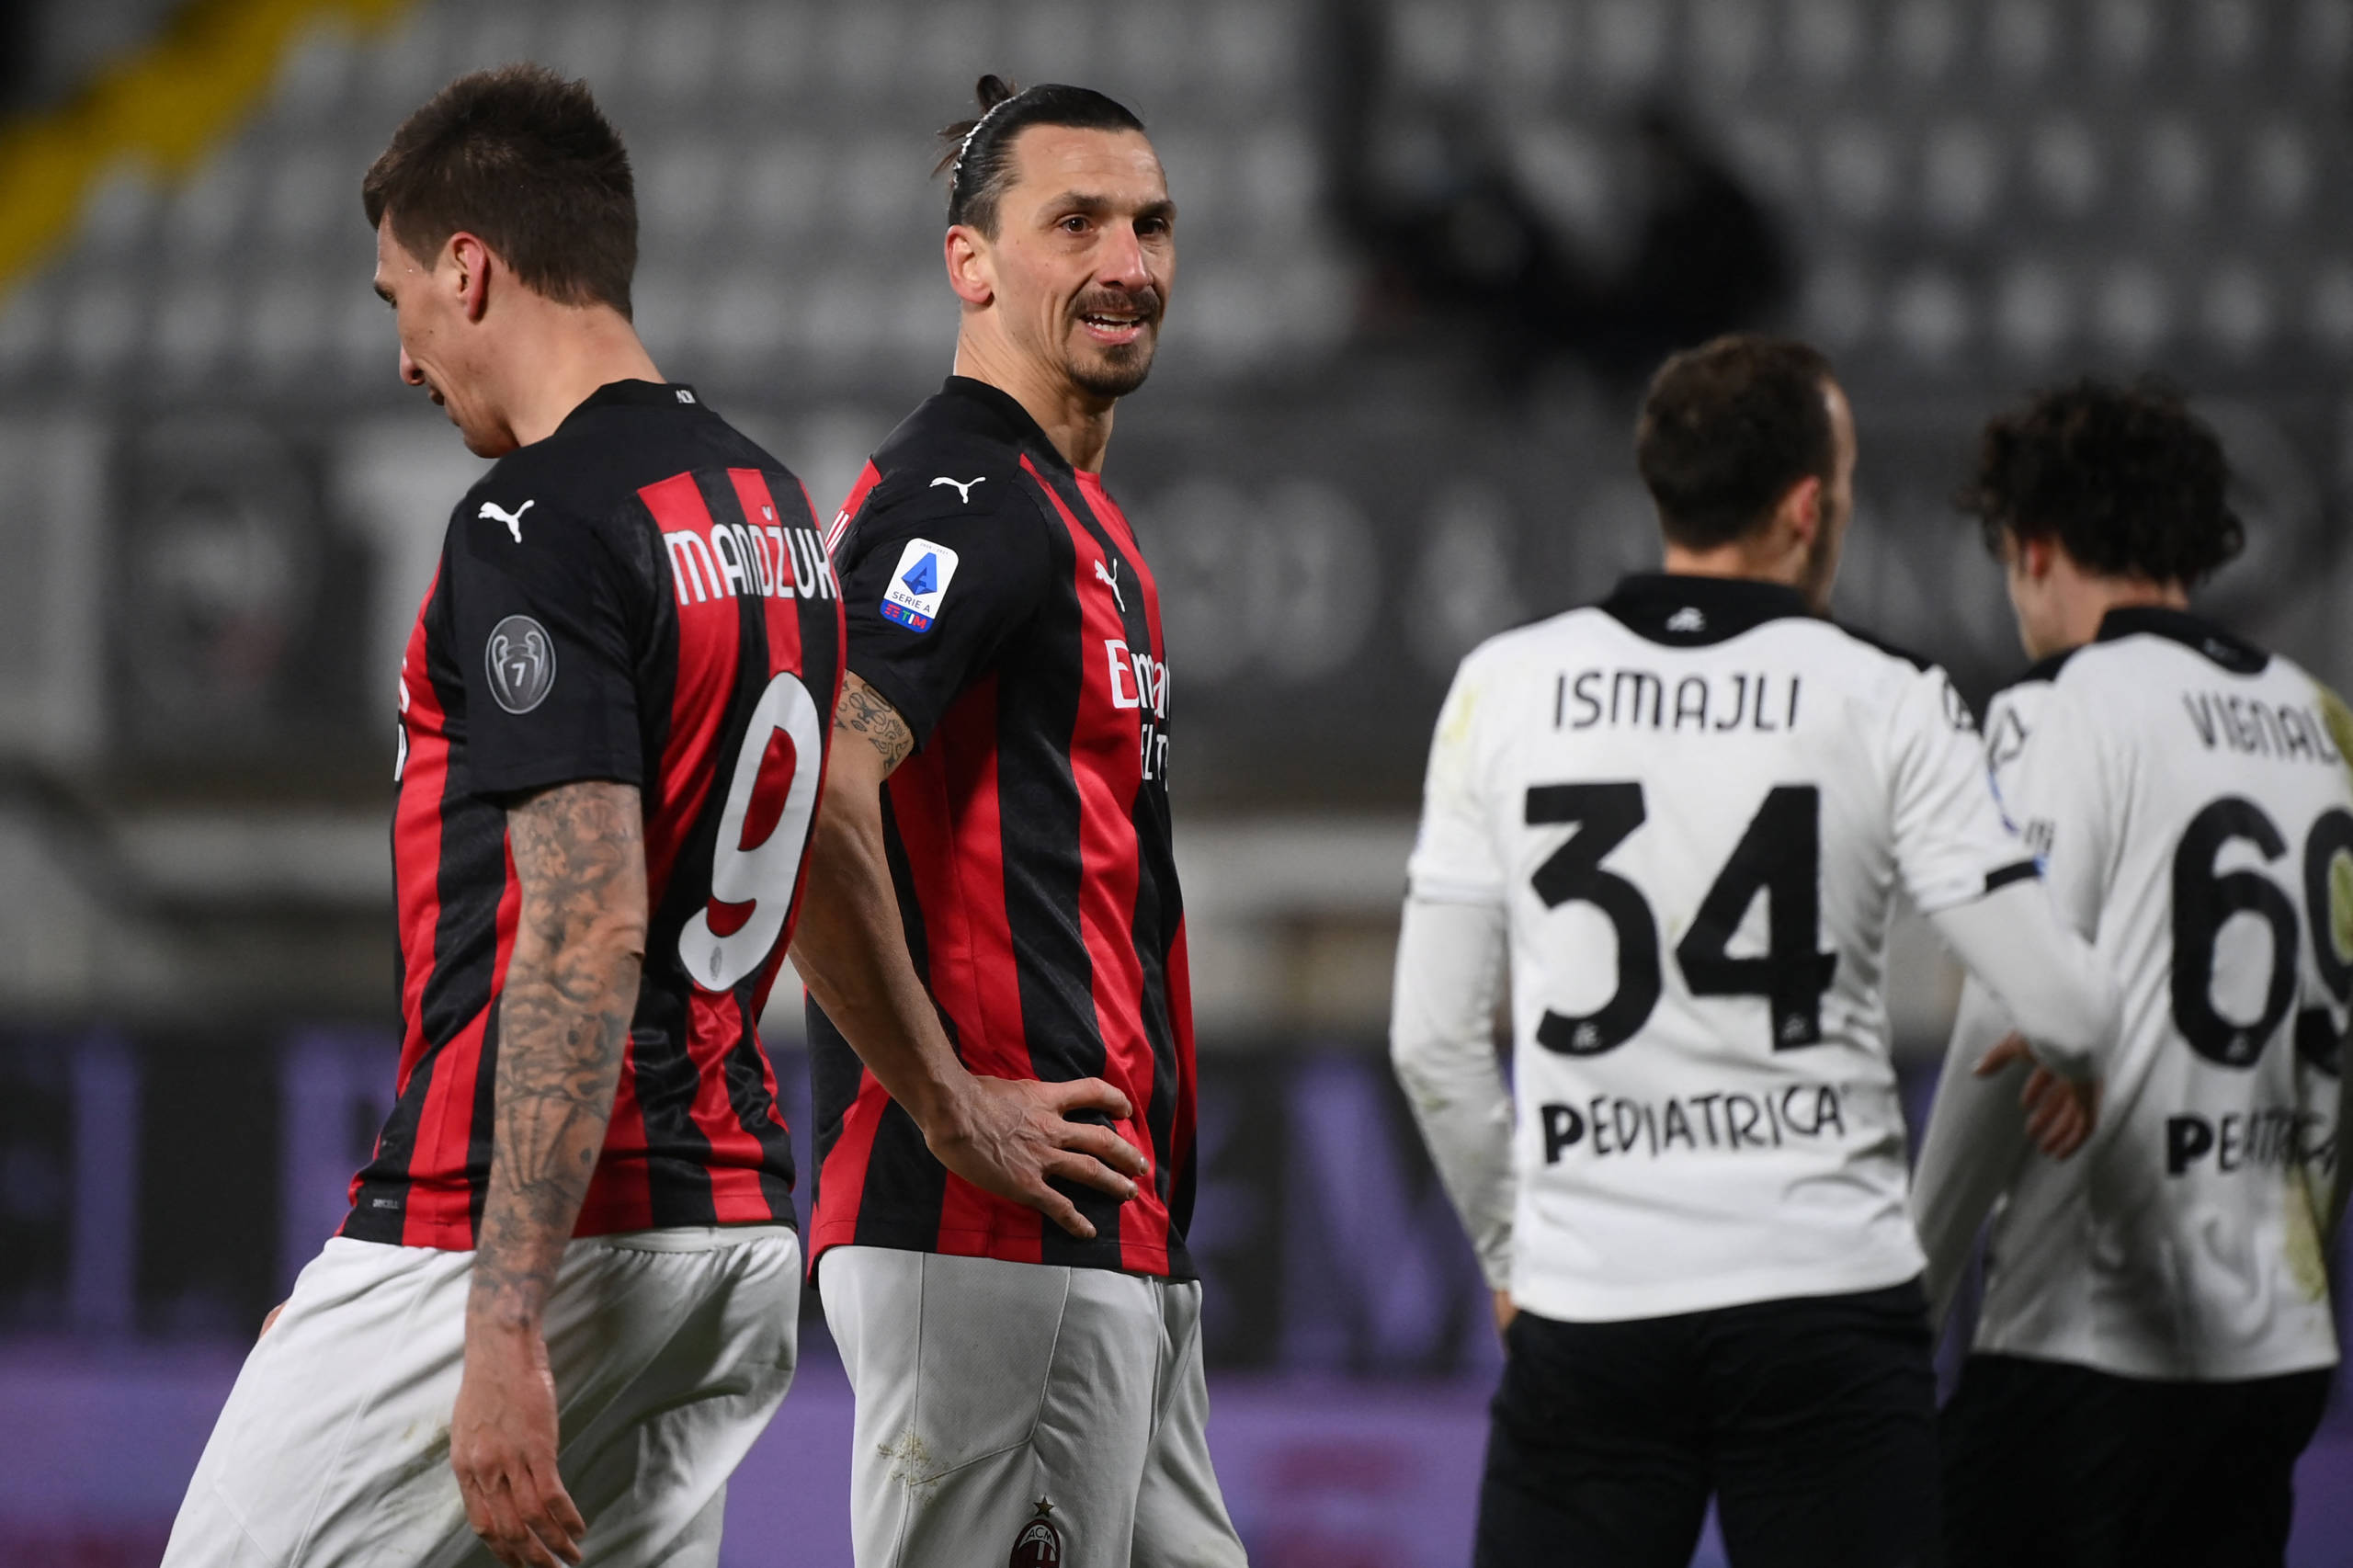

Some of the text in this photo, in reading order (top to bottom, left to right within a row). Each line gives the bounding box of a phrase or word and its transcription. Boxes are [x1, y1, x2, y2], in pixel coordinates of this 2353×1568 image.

[892, 591, 930, 614] SERIE A
[902, 609, 927, 630] TIM
[511, 662, 527, 687] 7
[1554, 669, 1801, 732] ISMAJLI
[678, 672, 822, 993] 9
[1524, 781, 1839, 1058] 34
[1541, 1084, 1846, 1165] PEDIATRICA
[1024, 1527, 1052, 1542] ACM
